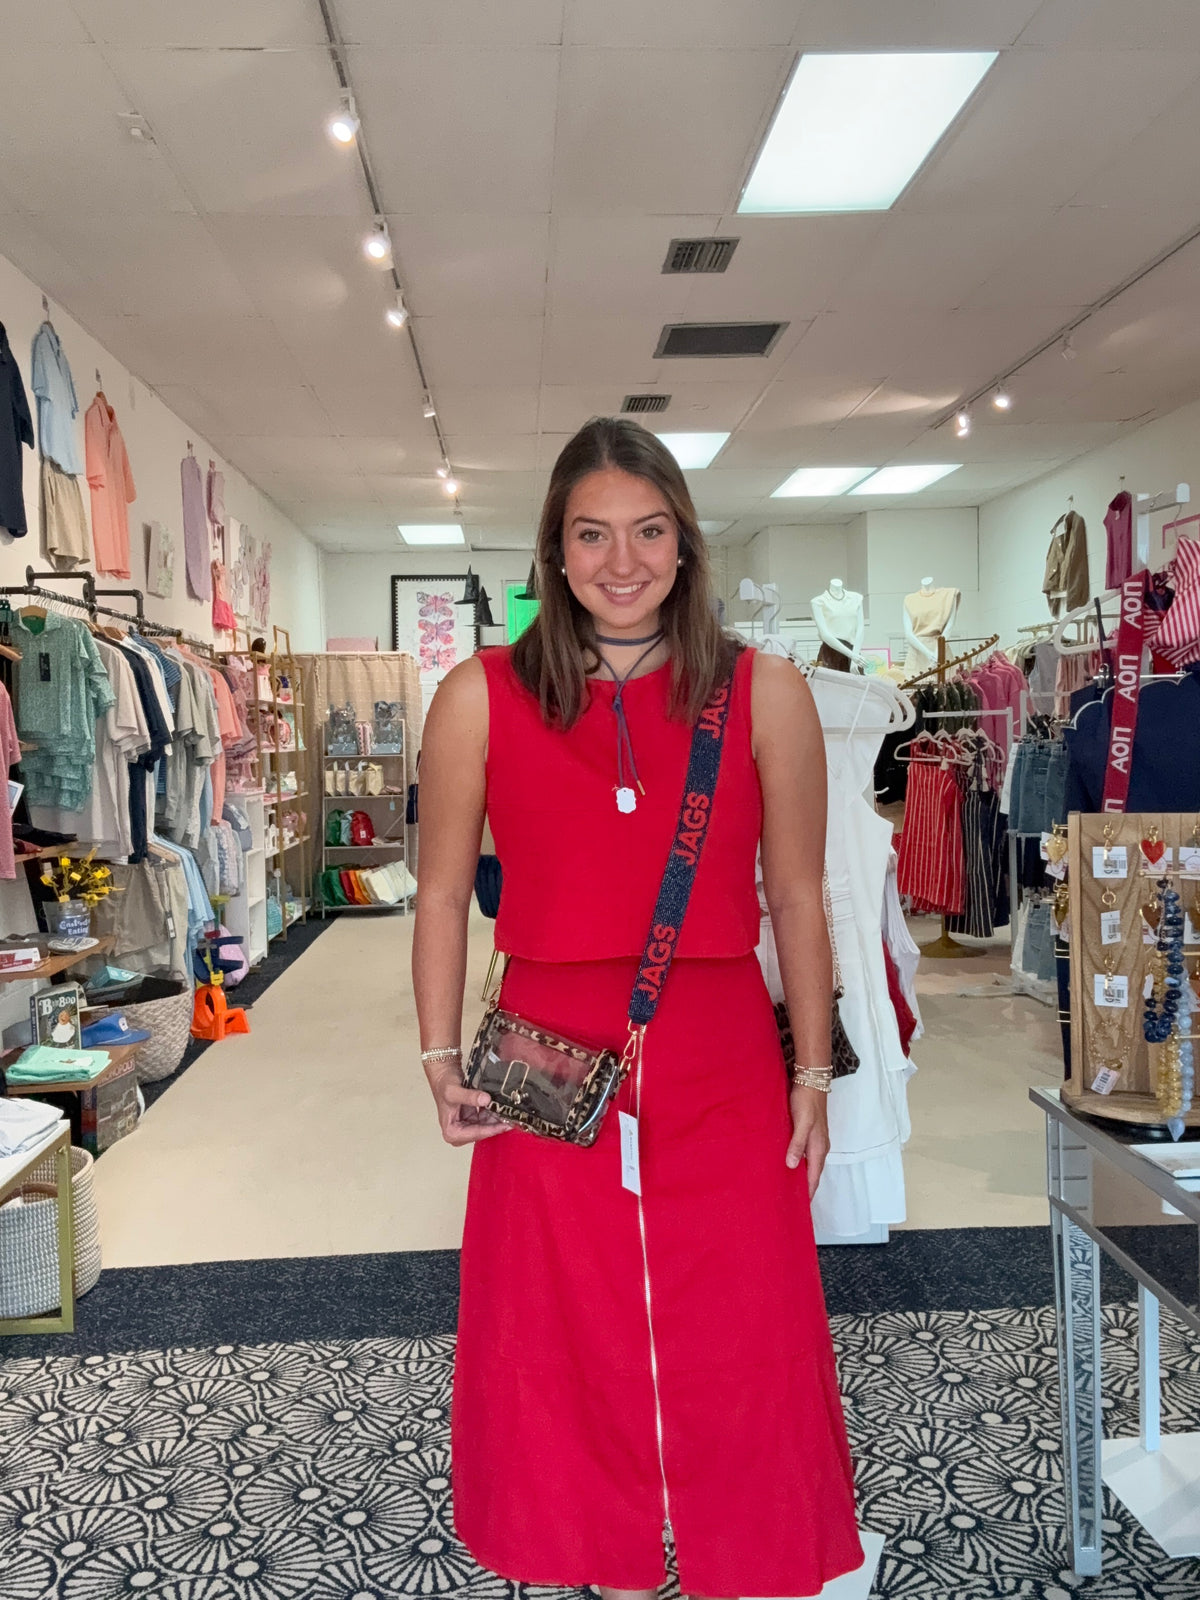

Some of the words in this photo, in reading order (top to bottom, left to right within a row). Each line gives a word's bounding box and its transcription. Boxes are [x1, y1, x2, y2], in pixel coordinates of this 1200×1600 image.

[698, 678, 730, 739] JAG
[674, 792, 709, 866] JAGS
[637, 924, 676, 1000] JAGS
